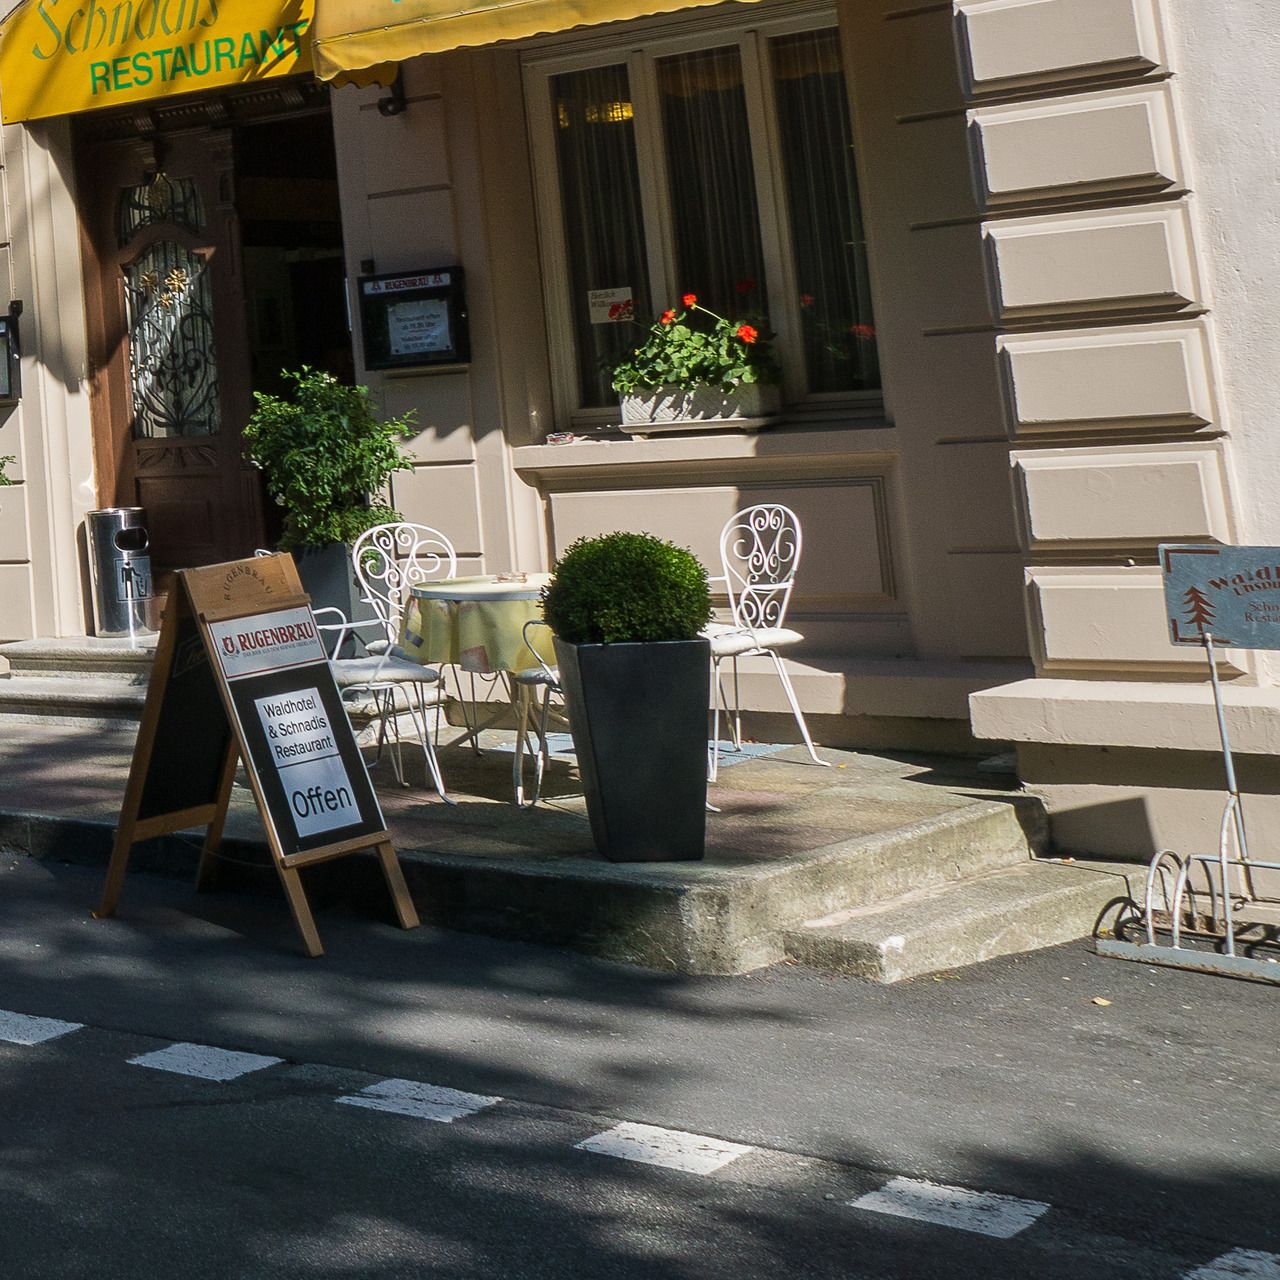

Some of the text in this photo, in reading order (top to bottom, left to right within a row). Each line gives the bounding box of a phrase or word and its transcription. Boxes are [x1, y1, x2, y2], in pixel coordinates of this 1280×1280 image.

[90, 18, 309, 96] RESTAURANT
[237, 622, 315, 651] RUGENBRÄU
[263, 696, 317, 719] Waldhotel
[268, 716, 327, 739] & Schnadis
[274, 735, 333, 759] Restaurant
[292, 785, 352, 818] Offen
